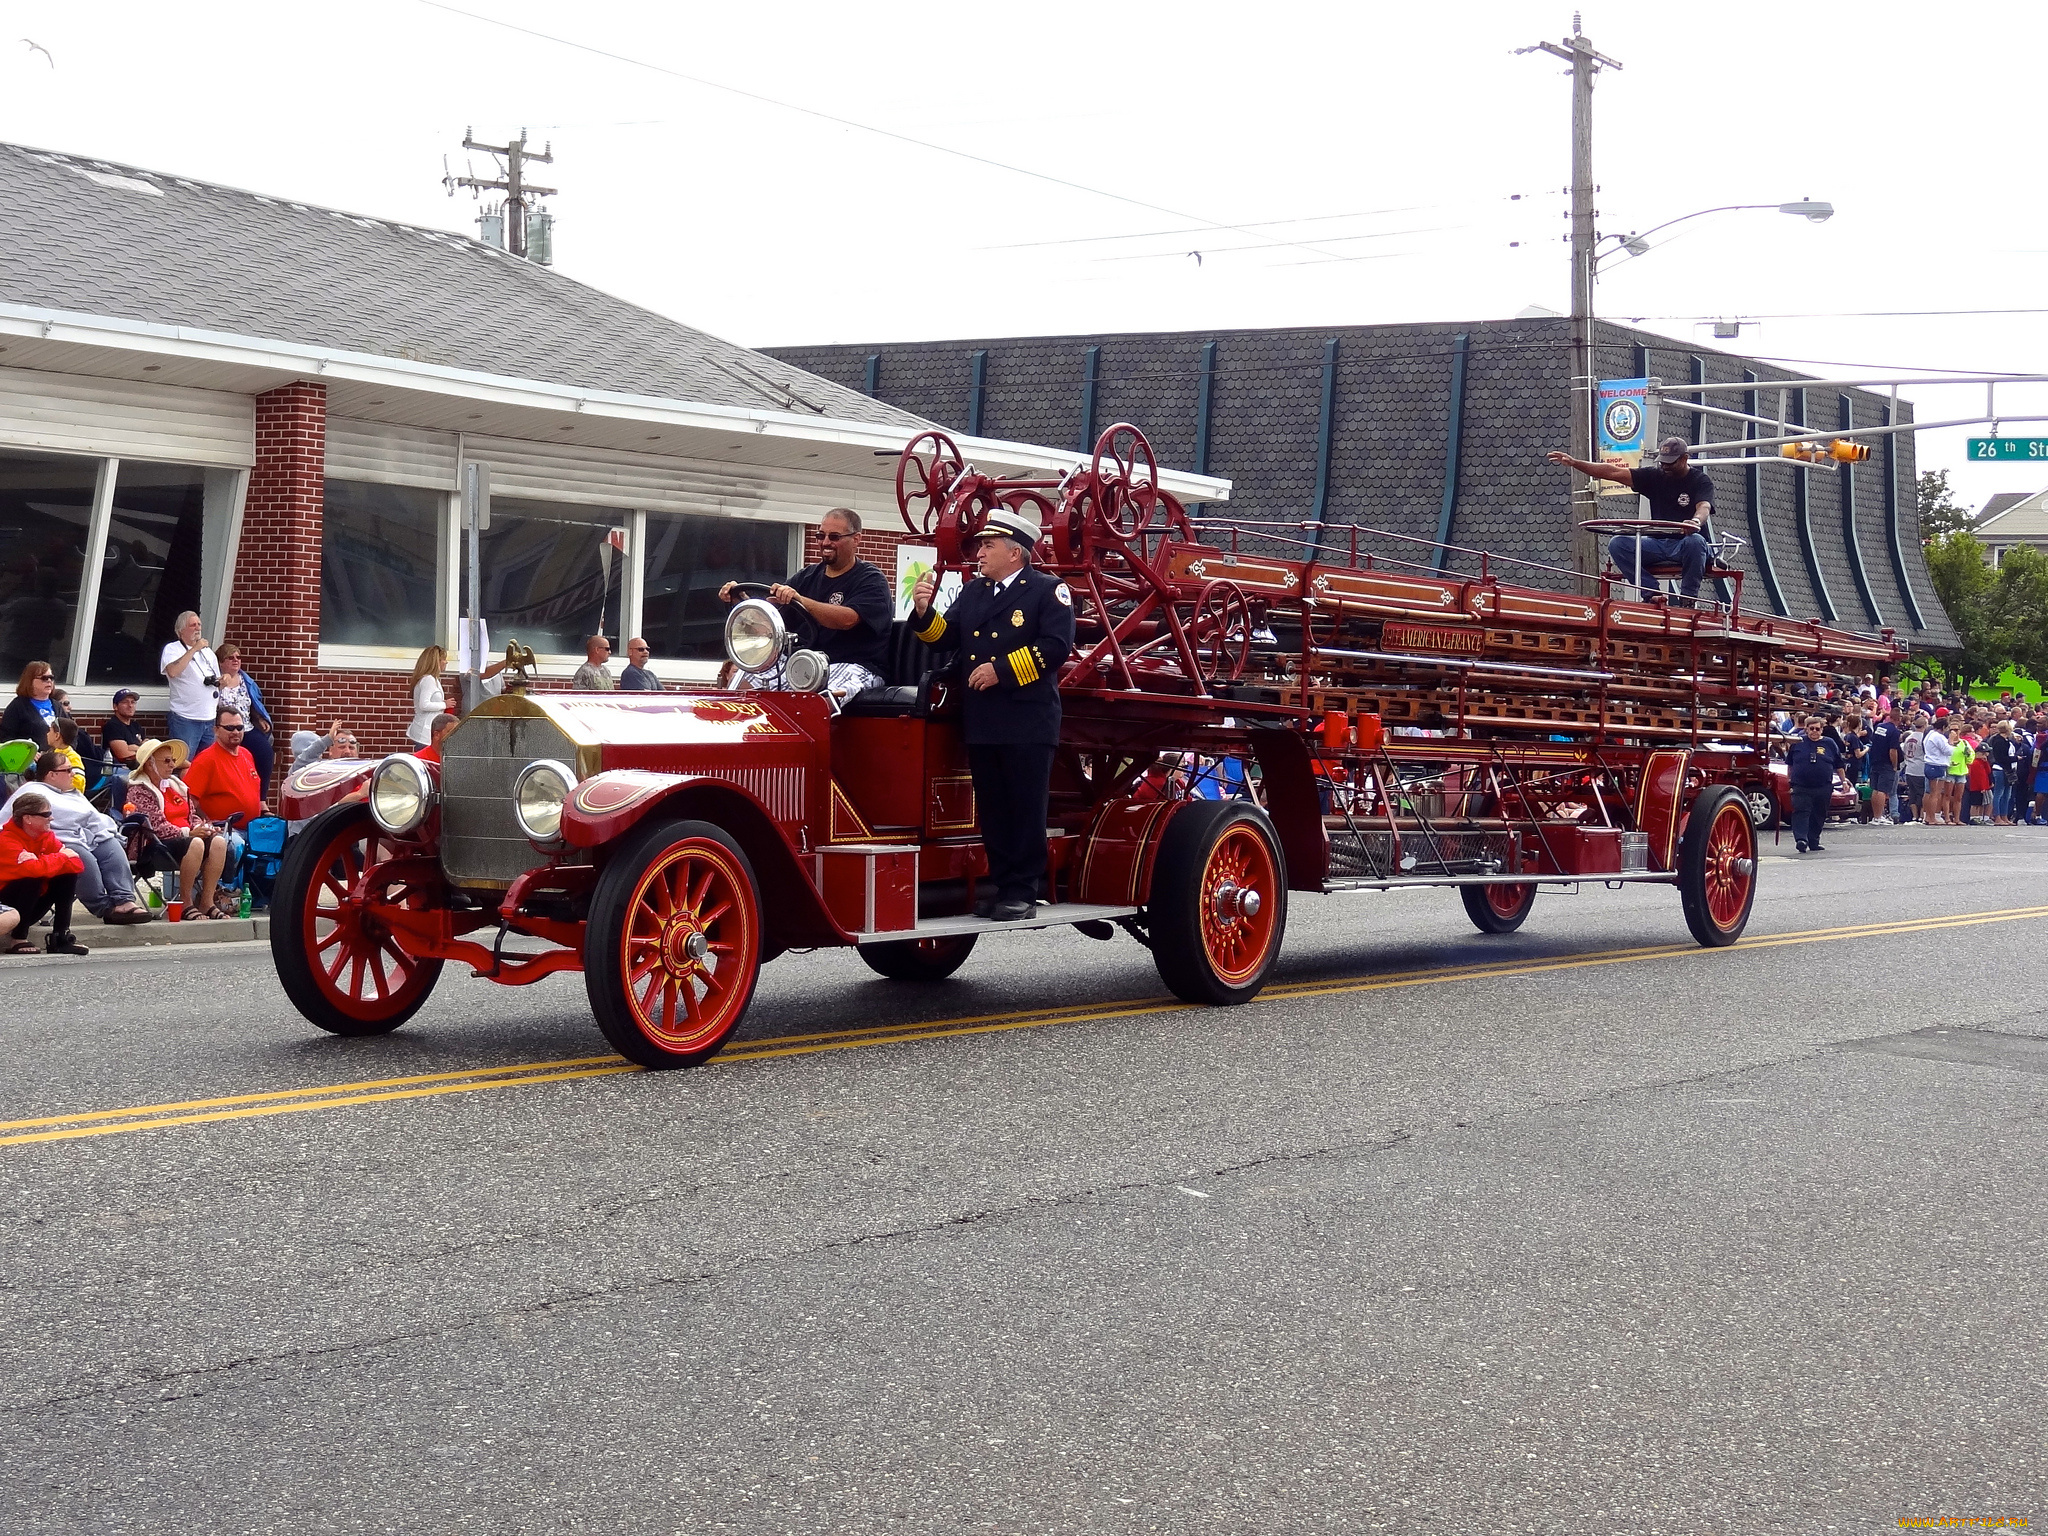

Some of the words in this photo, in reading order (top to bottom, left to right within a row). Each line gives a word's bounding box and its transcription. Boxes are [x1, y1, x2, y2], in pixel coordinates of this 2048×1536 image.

[1600, 388, 1648, 398] WELCOME
[1977, 441, 1997, 457] 26
[2004, 441, 2016, 452] th
[1400, 629, 1442, 649] AMERICAN
